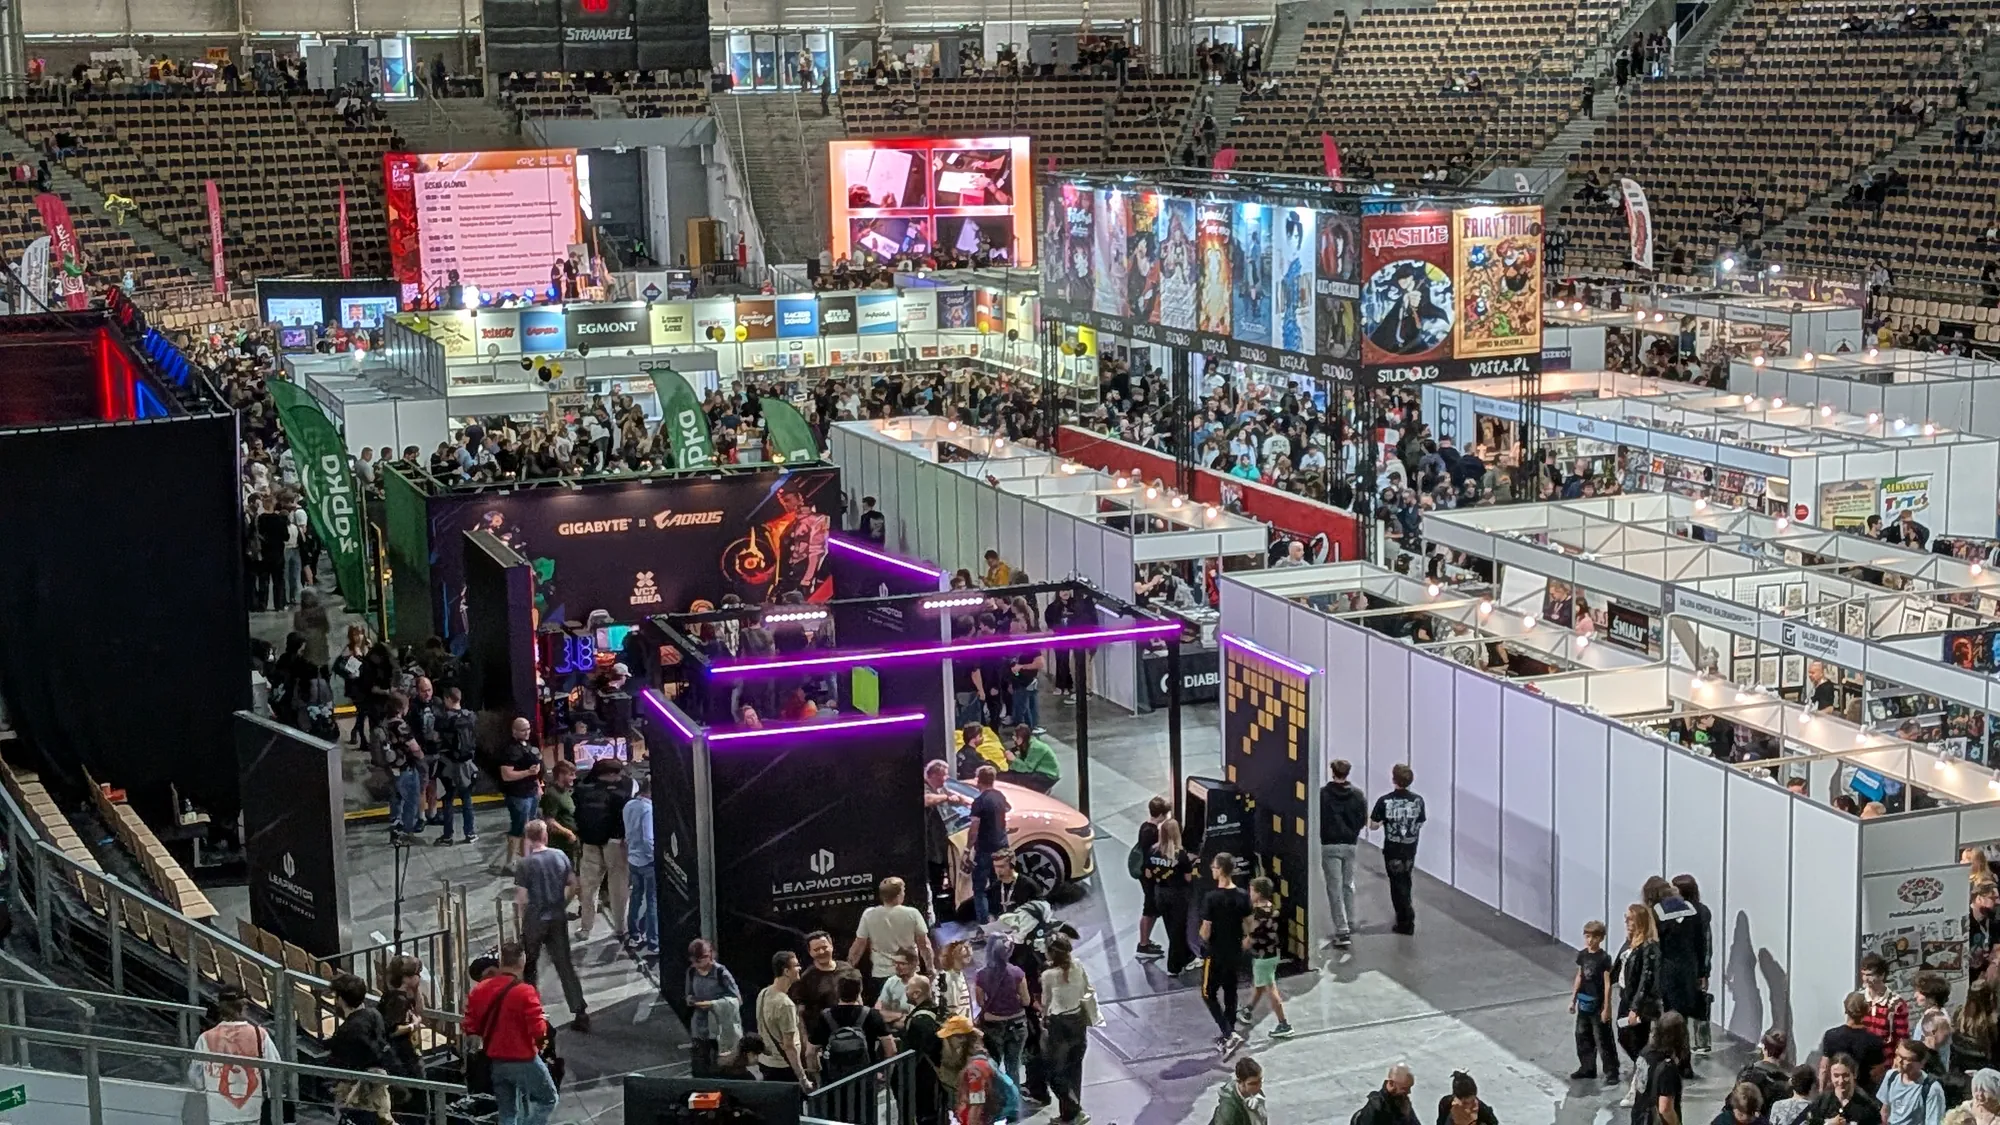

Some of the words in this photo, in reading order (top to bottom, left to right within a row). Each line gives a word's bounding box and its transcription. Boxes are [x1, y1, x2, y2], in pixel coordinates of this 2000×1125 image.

[565, 26, 634, 41] STRAMATEL
[1463, 216, 1500, 239] FAIRY
[1502, 214, 1532, 237] TAIL
[1368, 225, 1449, 256] MASHLE
[577, 320, 638, 335] EGMONT
[1469, 357, 1530, 377] YATTA.PL
[558, 518, 630, 536] GIGABYTE
[668, 510, 724, 527] AORUS
[630, 594, 662, 605] EMEA
[634, 586, 657, 596] VCT
[268, 871, 314, 903] LEAPMOTOR
[772, 873, 873, 895] LEAPMOTOR
[786, 901, 815, 911] LEAP
